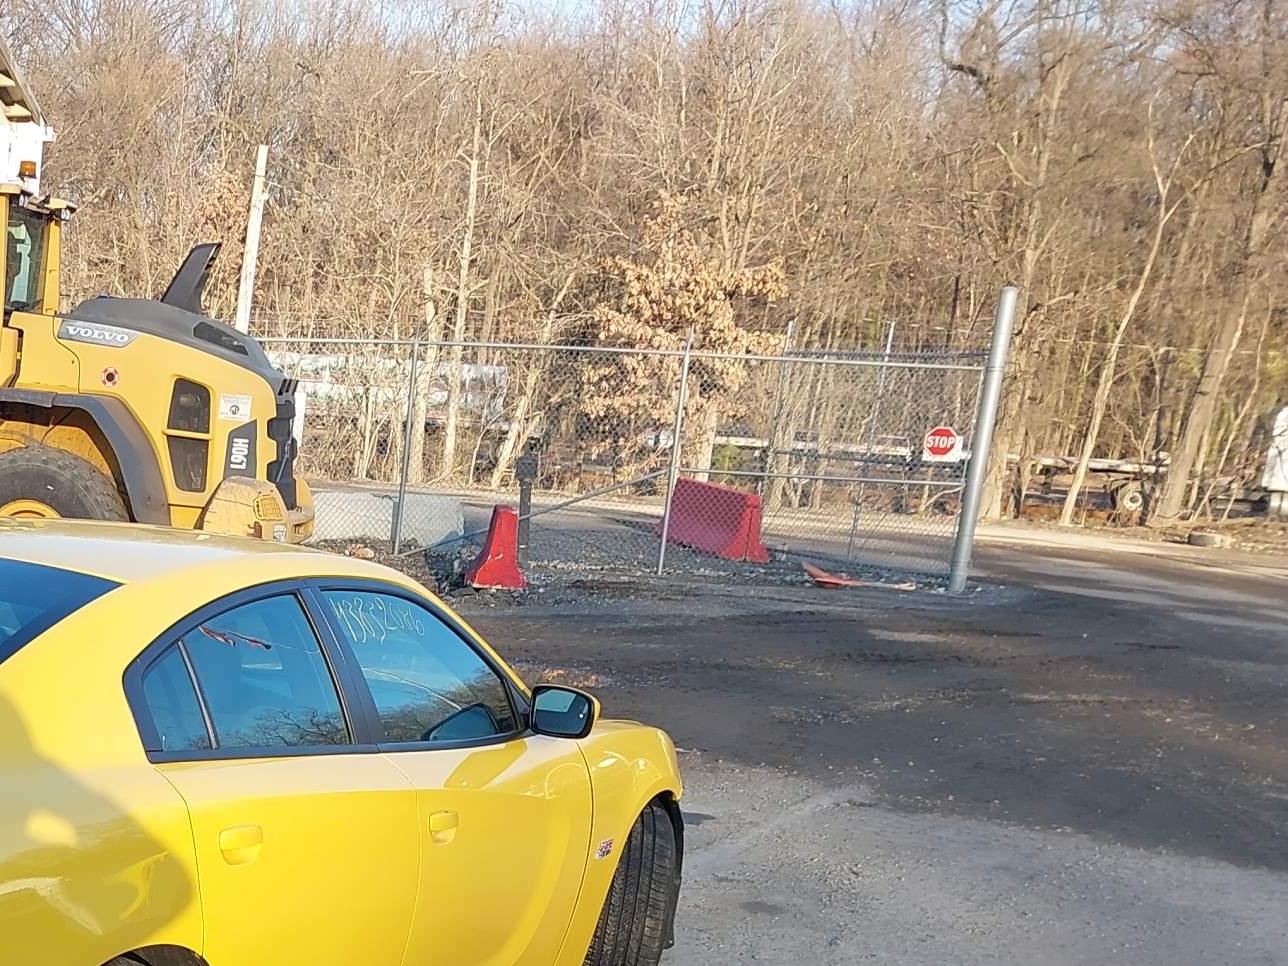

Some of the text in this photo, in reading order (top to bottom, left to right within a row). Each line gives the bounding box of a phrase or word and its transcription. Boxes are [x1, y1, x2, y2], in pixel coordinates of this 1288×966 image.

[66, 325, 129, 343] VOLVO
[926, 435, 955, 449] STOP
[230, 438, 249, 470] L90H
